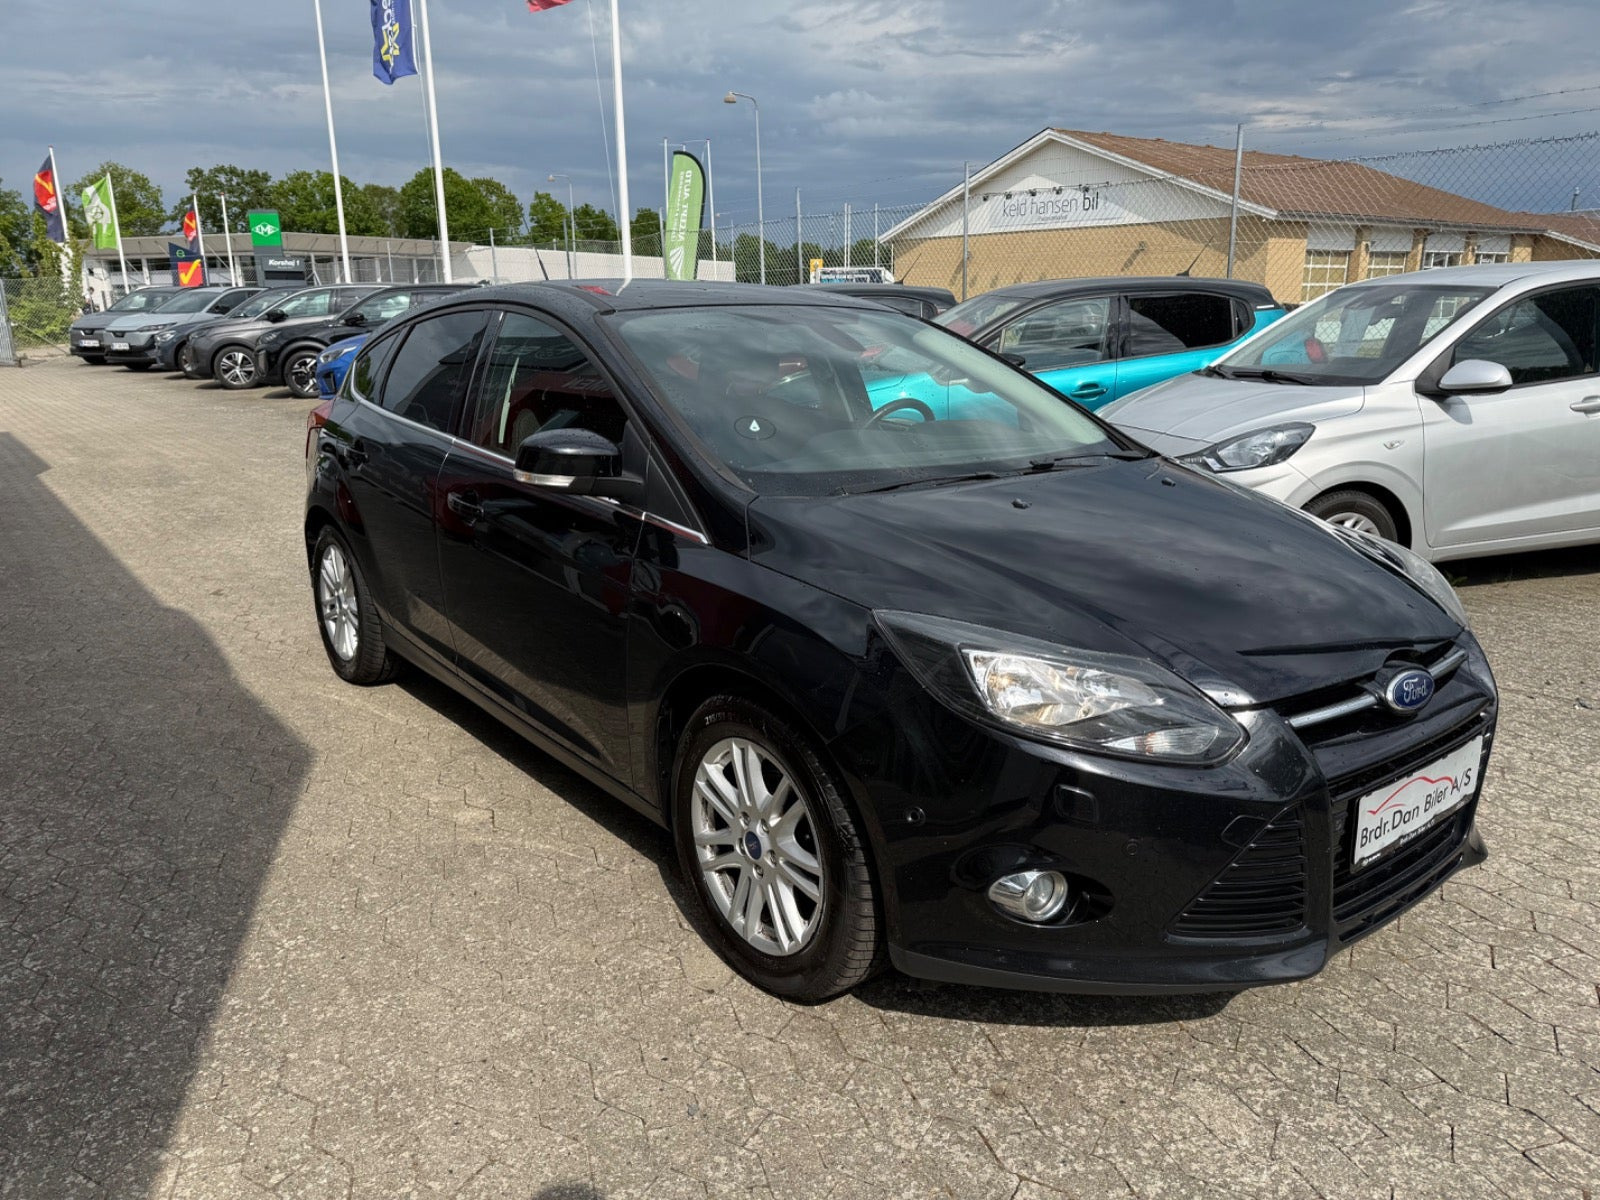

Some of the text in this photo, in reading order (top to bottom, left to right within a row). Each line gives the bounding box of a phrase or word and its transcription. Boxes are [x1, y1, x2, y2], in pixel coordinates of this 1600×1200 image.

[1002, 199, 1027, 218] keld
[1030, 197, 1079, 216] hansen
[1082, 190, 1099, 212] bil
[1403, 677, 1428, 704] Ford
[1424, 786, 1449, 813] Biler
[1451, 767, 1473, 795] A/S
